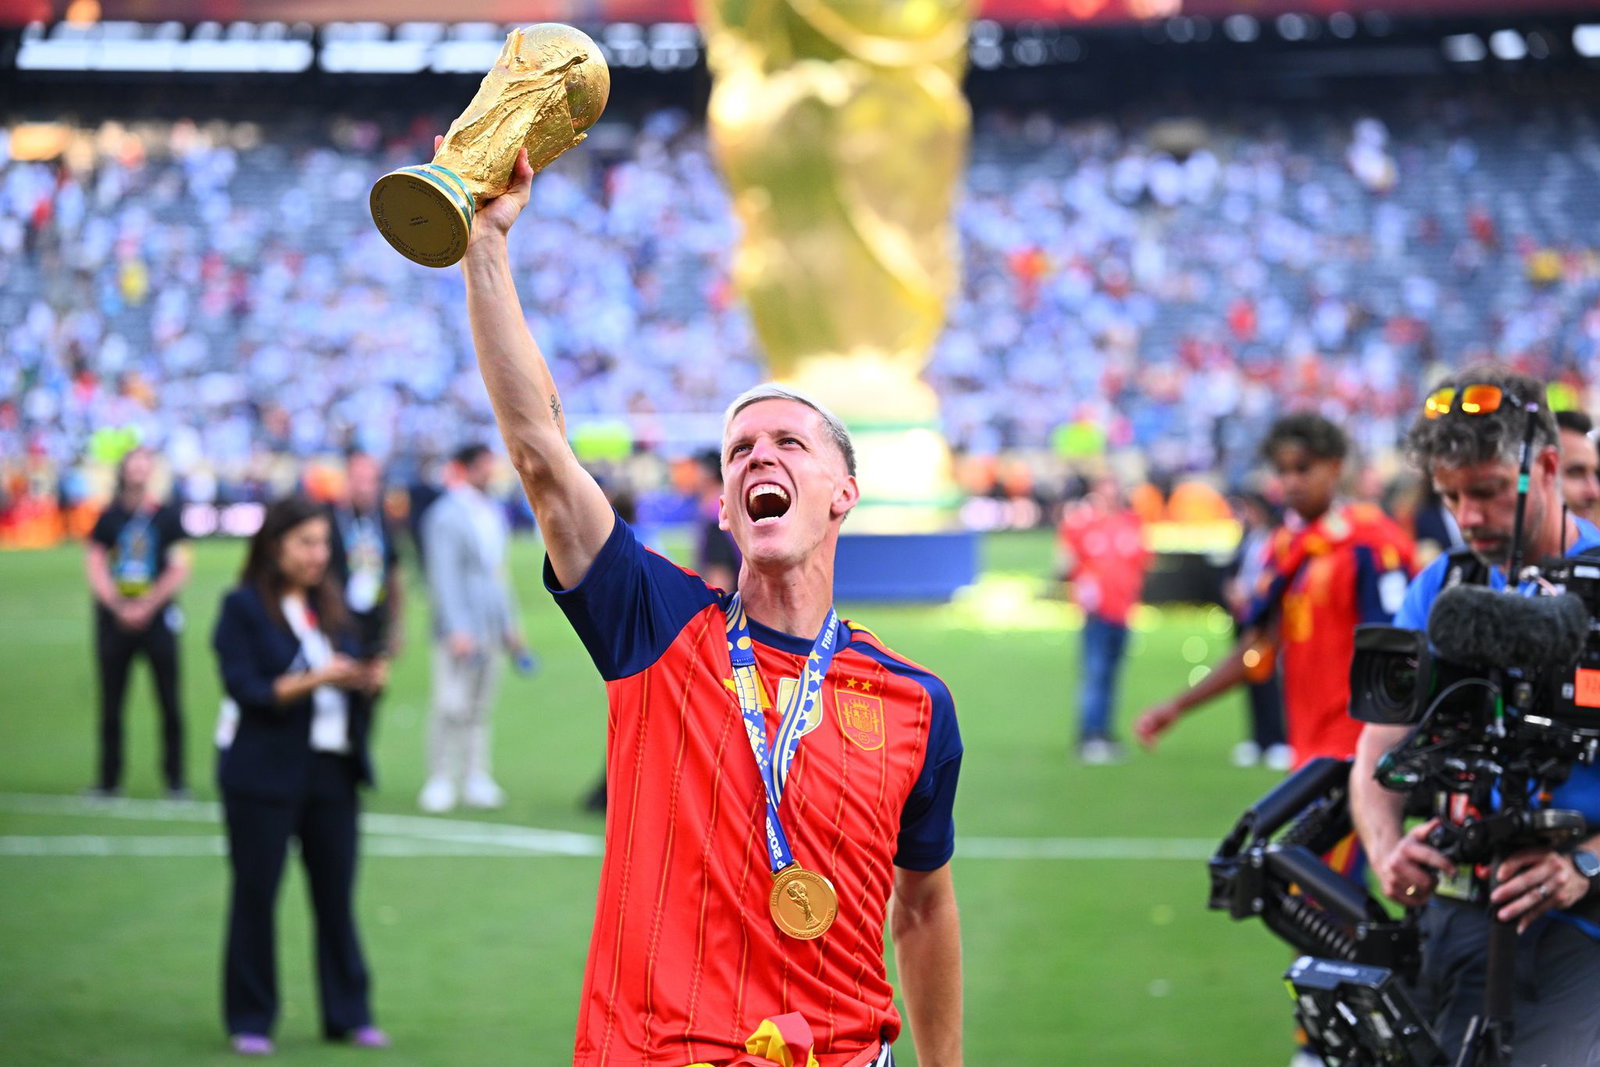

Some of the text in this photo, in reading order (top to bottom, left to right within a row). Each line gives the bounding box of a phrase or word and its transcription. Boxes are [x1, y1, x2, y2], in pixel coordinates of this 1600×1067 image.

[821, 609, 838, 650] FIFA WO
[766, 816, 783, 858] 2026
